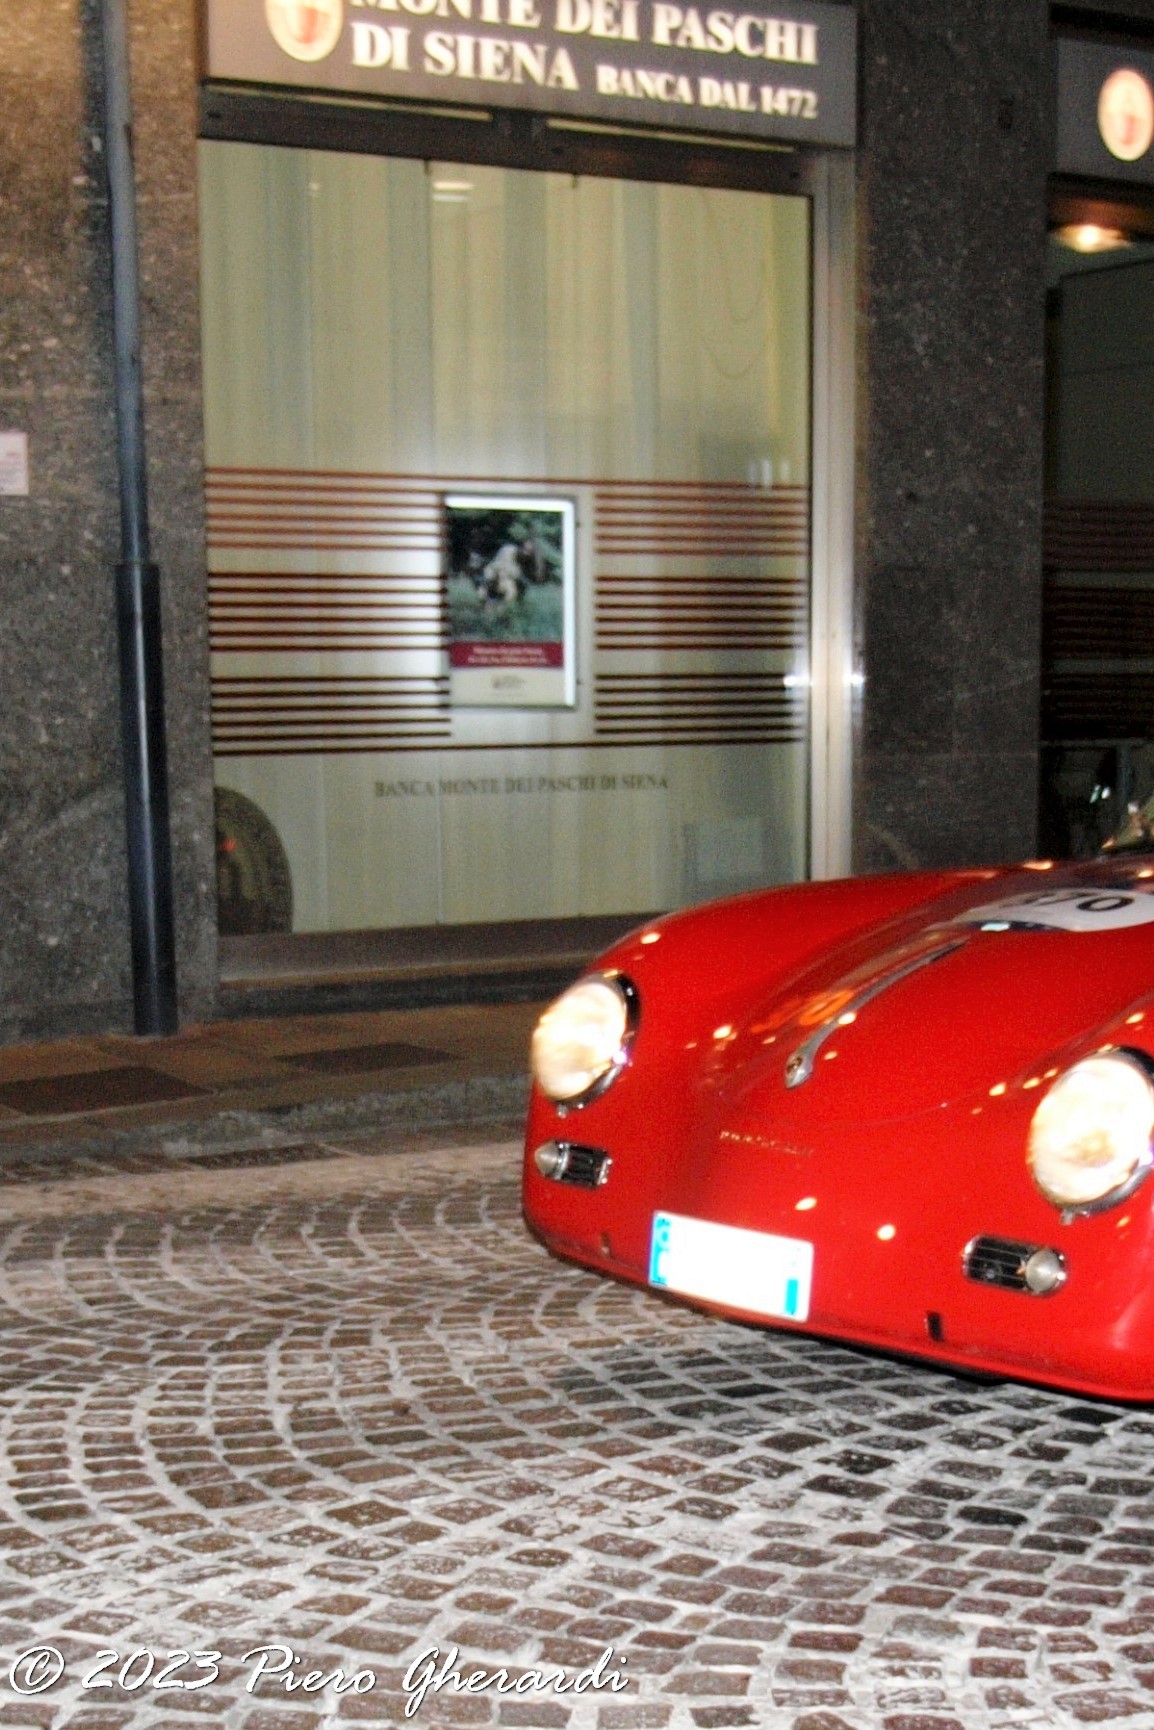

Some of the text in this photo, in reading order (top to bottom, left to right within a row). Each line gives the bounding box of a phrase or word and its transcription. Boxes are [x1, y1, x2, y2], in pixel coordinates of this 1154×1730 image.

[554, 0, 640, 42] DEI
[652, 3, 818, 65] PASCHI
[350, 21, 818, 119] DI SIENA BANCA DAL 1472
[374, 779, 434, 799] BANCA
[438, 777, 499, 796] MONTE
[505, 776, 533, 794] DEI
[537, 774, 595, 792] PASCHI
